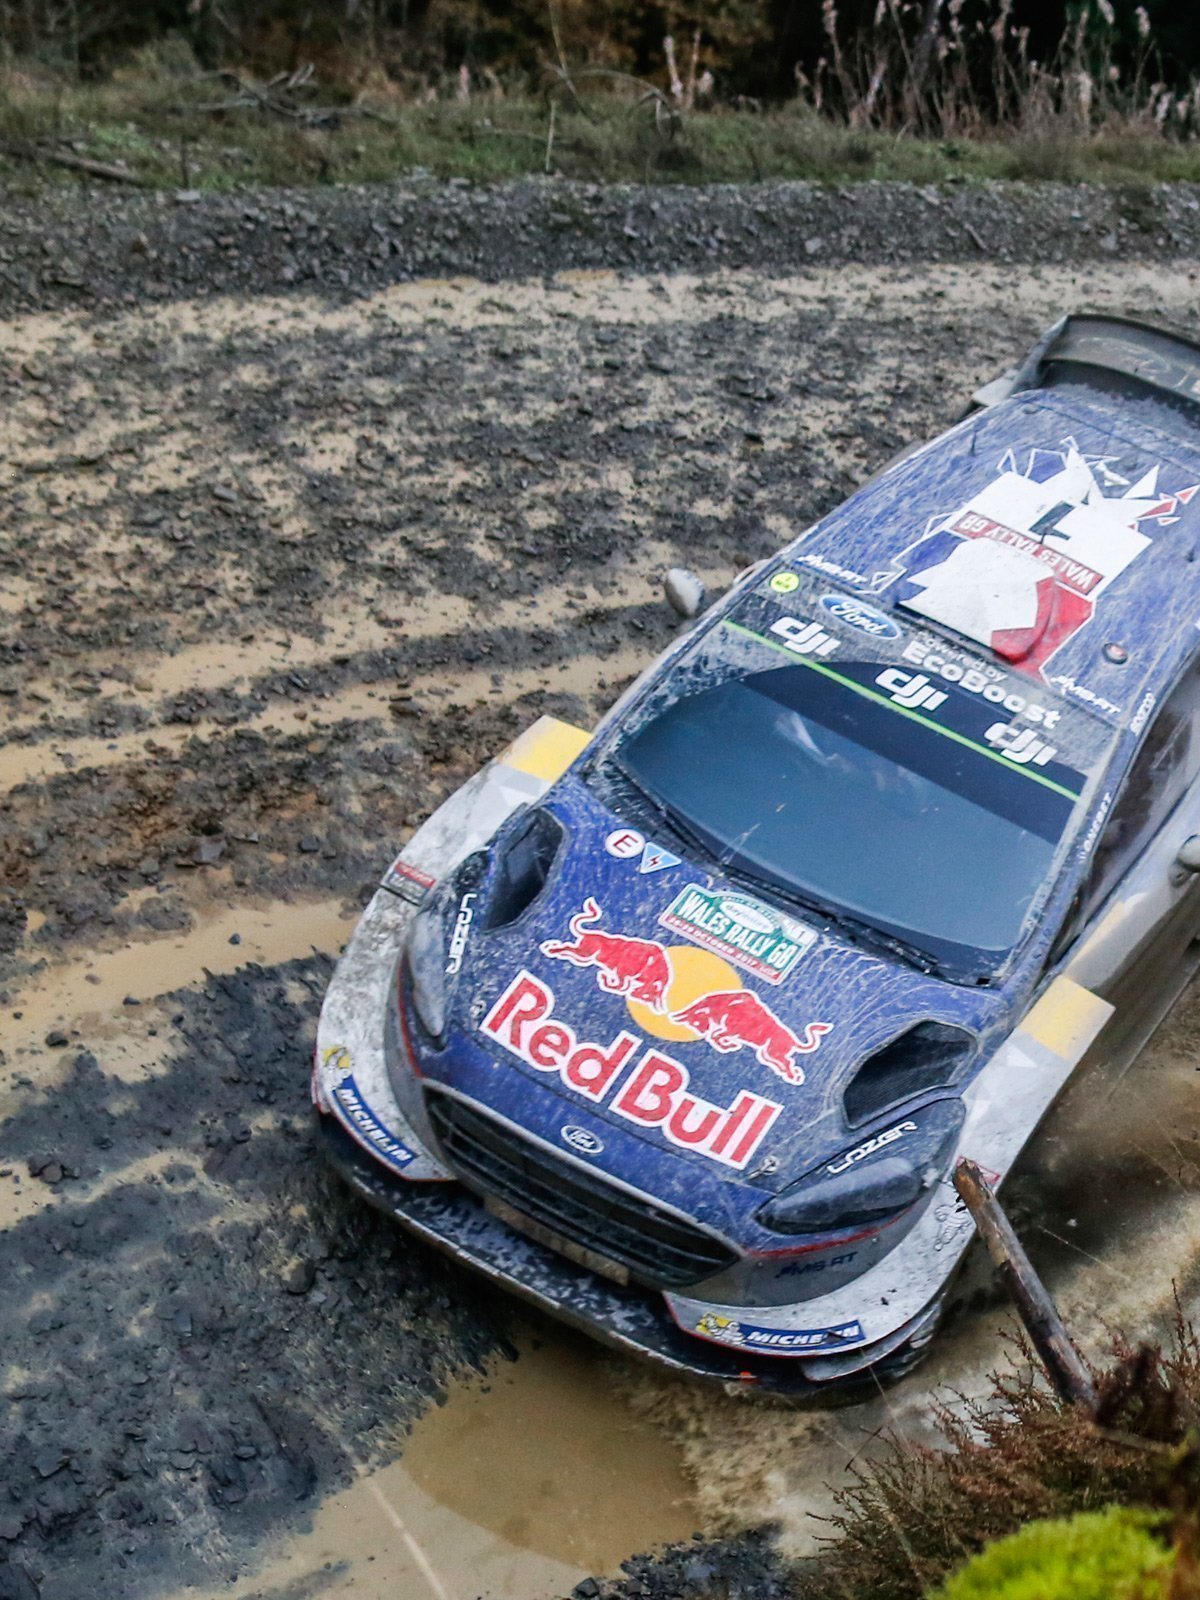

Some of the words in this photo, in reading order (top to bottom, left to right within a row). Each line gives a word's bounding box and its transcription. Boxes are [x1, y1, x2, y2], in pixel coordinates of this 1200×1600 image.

[959, 514, 989, 533] GB
[985, 525, 1041, 556] RALLY
[1040, 549, 1096, 590] WALES
[829, 600, 889, 635] Ford
[902, 640, 1062, 730] EcoBoost
[985, 665, 1010, 684] by
[613, 834, 639, 854] E
[445, 893, 477, 974] LAZER
[677, 890, 731, 935] WALES
[724, 922, 777, 957] RALLY
[767, 942, 798, 969] GB
[479, 970, 642, 1103] Red
[608, 1049, 785, 1171] Bull
[340, 1088, 412, 1161] MICHELIN
[826, 1121, 918, 1175] LAZER
[748, 1325, 860, 1346] MICHEN
